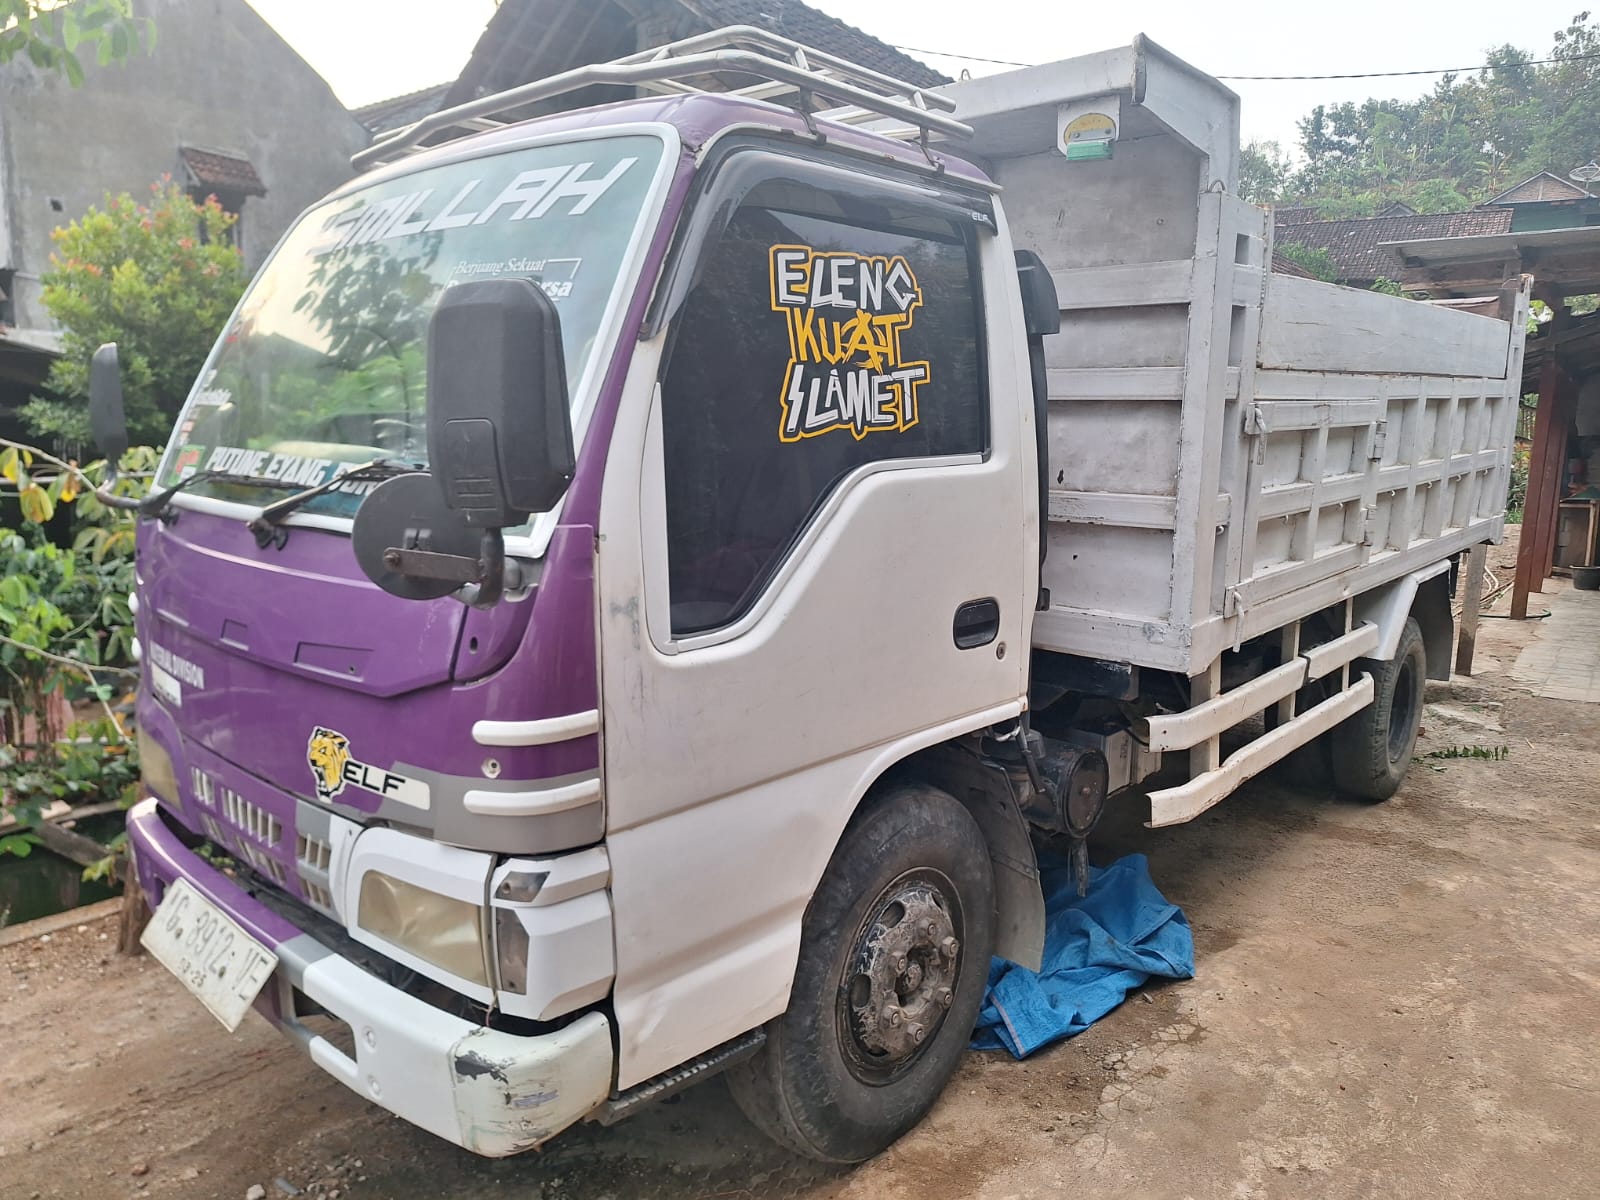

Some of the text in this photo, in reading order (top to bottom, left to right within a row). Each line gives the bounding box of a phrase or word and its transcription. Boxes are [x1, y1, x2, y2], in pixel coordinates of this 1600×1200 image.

[504, 257, 547, 272] Sekuat
[777, 251, 917, 311] ELENG
[793, 308, 908, 376] KUAT
[264, 453, 333, 487] EYANG
[342, 761, 406, 794] ELF
